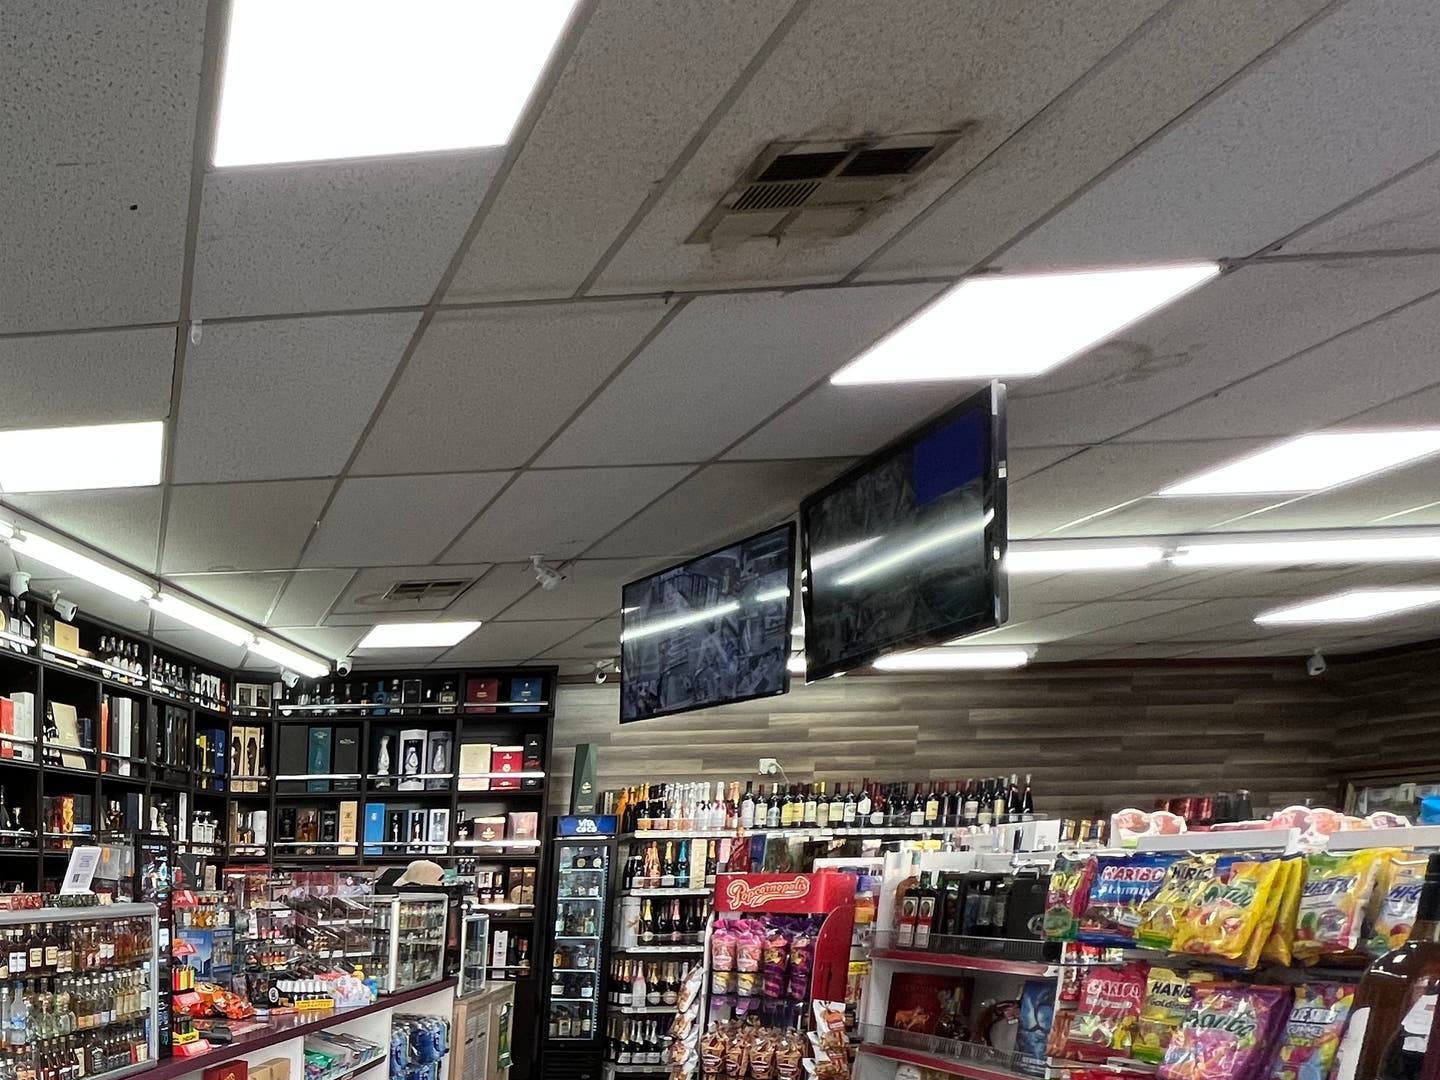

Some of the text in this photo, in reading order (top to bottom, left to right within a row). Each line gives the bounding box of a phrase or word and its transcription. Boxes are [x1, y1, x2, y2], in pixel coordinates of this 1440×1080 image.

[1103, 866, 1165, 882] HARIBO
[727, 876, 809, 909] Popcornopolis
[1152, 981, 1192, 998] HARIB
